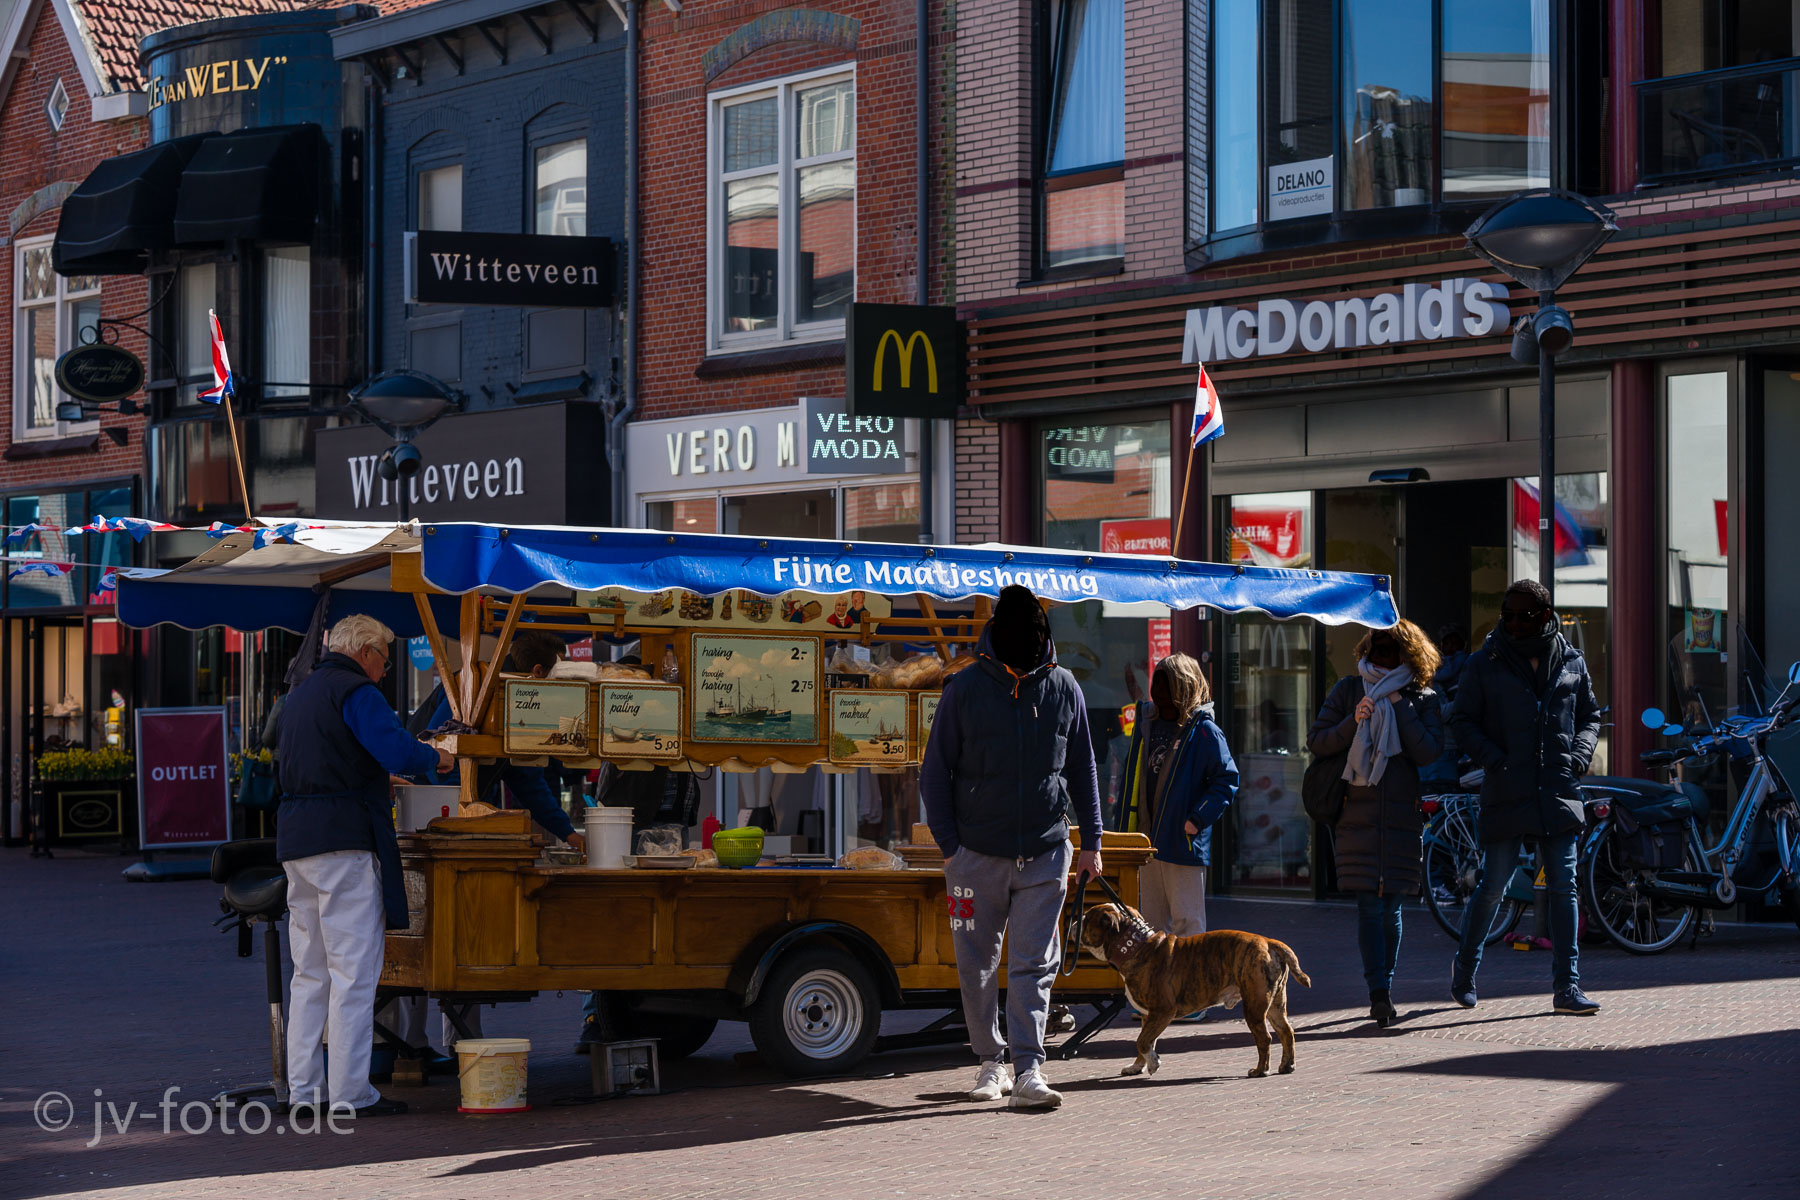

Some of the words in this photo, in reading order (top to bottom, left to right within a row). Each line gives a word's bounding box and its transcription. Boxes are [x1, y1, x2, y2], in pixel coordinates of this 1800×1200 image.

[162, 81, 187, 105] VAN
[1277, 169, 1325, 191] DELANO
[430, 252, 600, 285] Witteveen
[1181, 277, 1512, 364] McDonald's
[837, 413, 894, 433] VERO
[667, 425, 755, 476] VERO
[811, 438, 900, 459] MODA
[772, 556, 853, 586] Fijne
[865, 560, 1099, 596] Maatjesharing
[702, 646, 733, 660] haring
[701, 669, 724, 680] broodje
[515, 688, 540, 700] broodje
[701, 680, 733, 693] haring
[791, 680, 813, 693] 2.75
[515, 699, 540, 710] zalm
[610, 692, 634, 703] broodje
[609, 702, 641, 716] paling
[839, 708, 871, 719] makreel
[882, 742, 904, 754] 3.50
[152, 765, 217, 781] OUTLET
[1741, 802, 1758, 840] GIANT
[953, 886, 974, 898] SD
